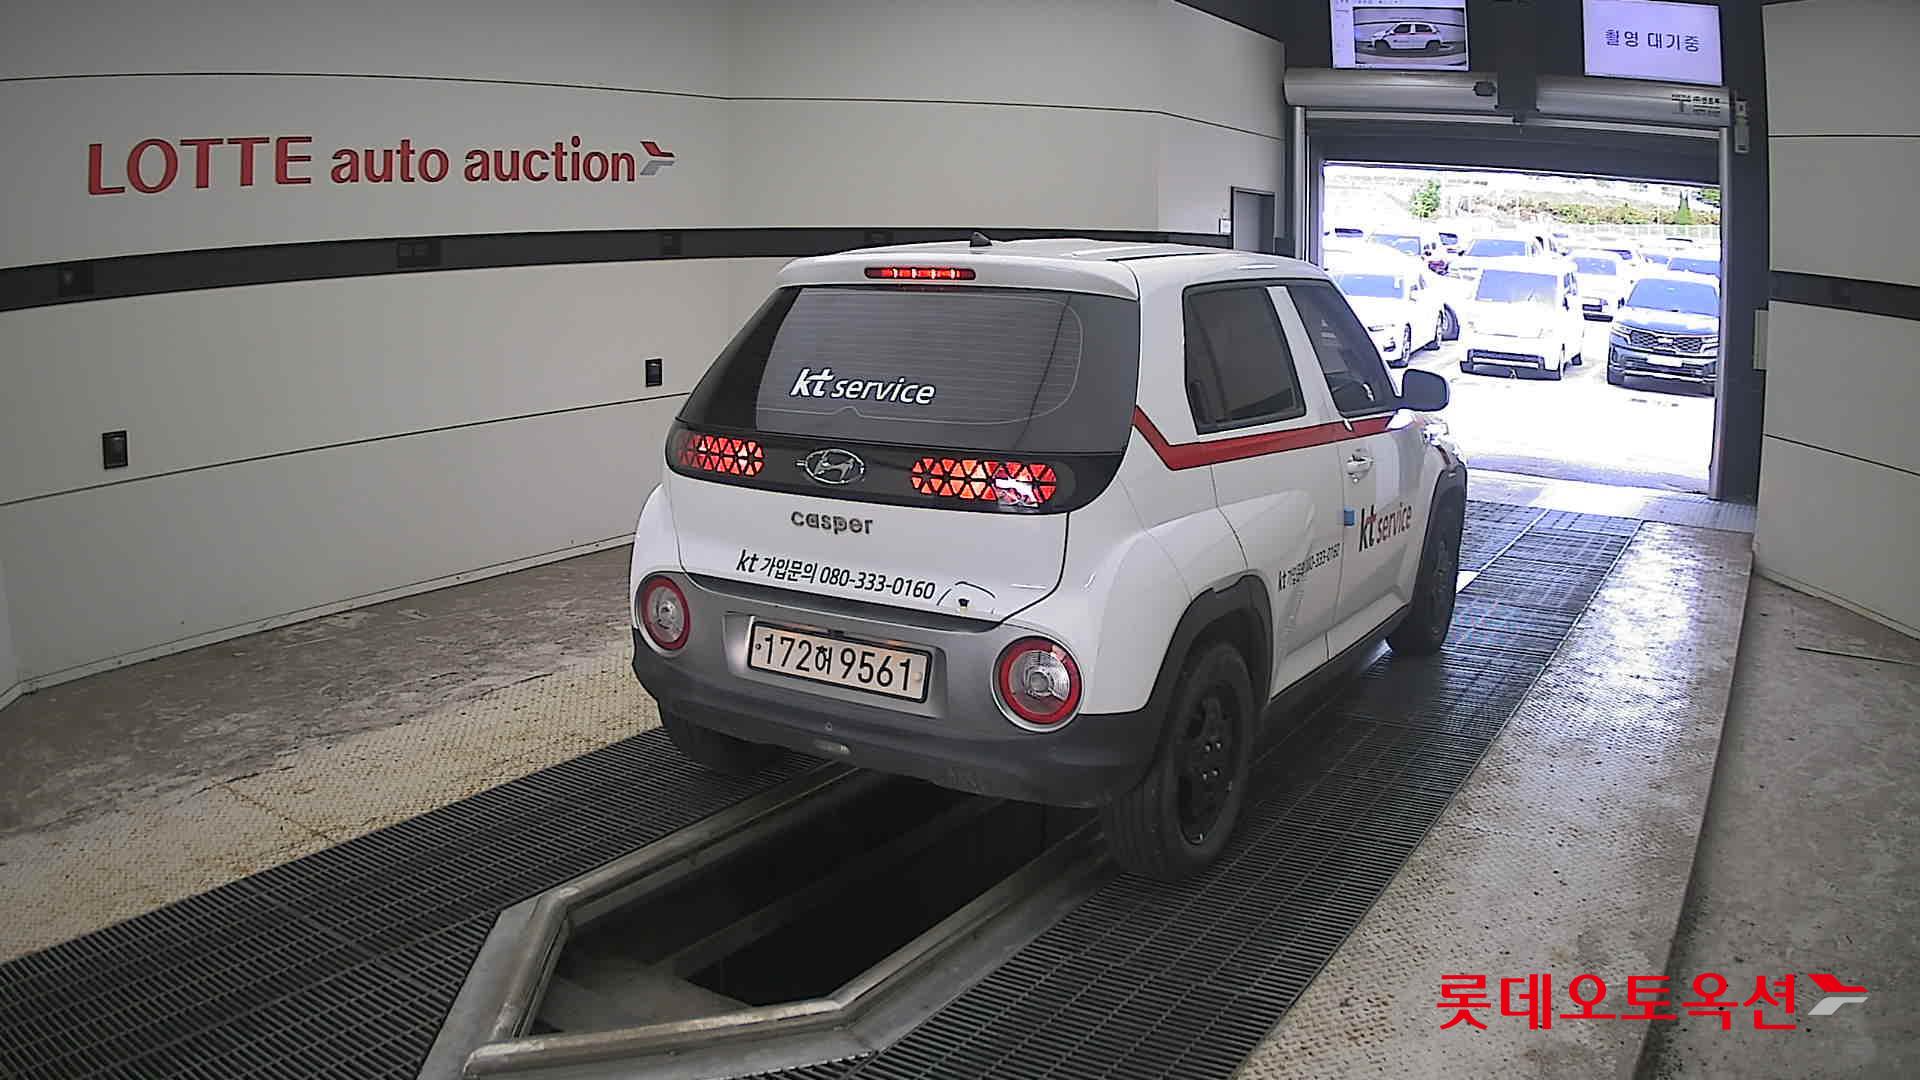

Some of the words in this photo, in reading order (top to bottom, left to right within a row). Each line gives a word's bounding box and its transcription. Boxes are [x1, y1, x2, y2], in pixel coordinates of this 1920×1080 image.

[1647, 31, 1699, 53] 대기중
[88, 136, 313, 195] LOTTE
[329, 139, 449, 184] auto
[463, 135, 636, 183] auction
[789, 367, 835, 397] kt
[831, 377, 936, 405] service
[791, 511, 874, 536] casper
[1358, 503, 1377, 553] kt
[1376, 501, 1412, 545] service
[736, 549, 759, 573] kt
[760, 556, 818, 584] 가입문의
[819, 565, 937, 600] 080-333-0160
